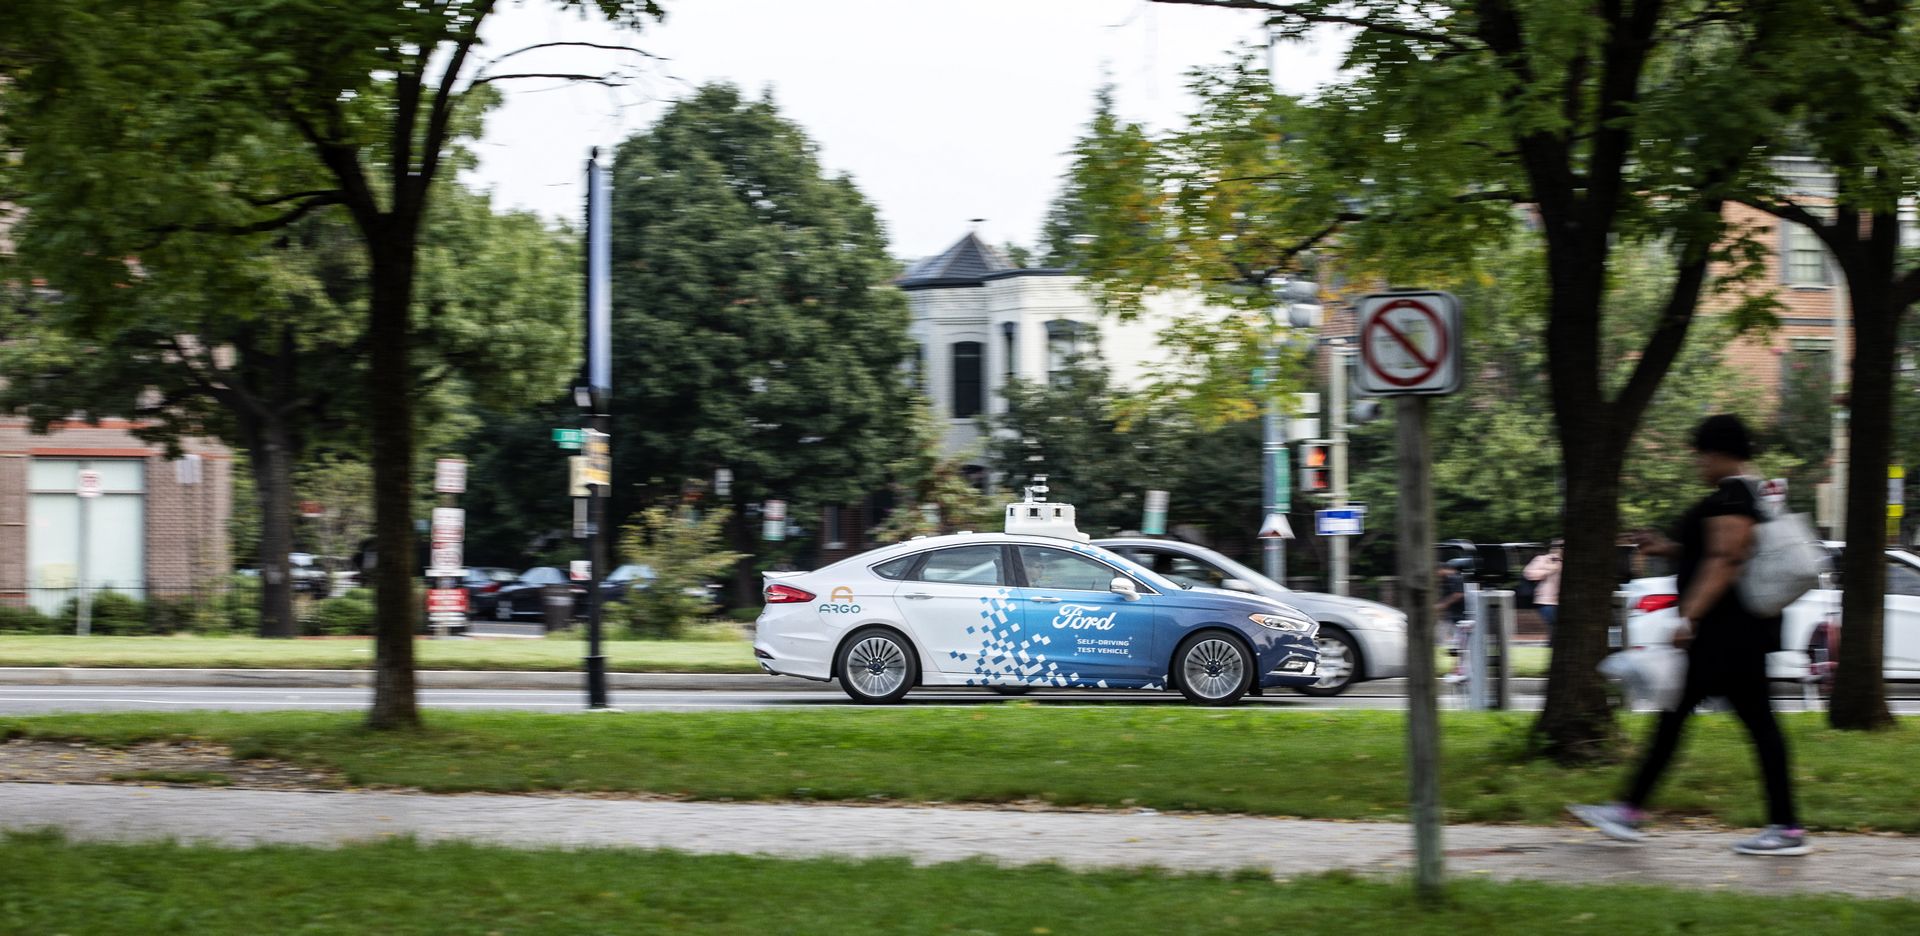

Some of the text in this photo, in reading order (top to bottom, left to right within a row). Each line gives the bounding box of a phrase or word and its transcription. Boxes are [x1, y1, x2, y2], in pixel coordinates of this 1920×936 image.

[819, 604, 861, 613] ARGO
[1052, 604, 1117, 630] Ford
[1076, 638, 1130, 646] SELF-DRIVING
